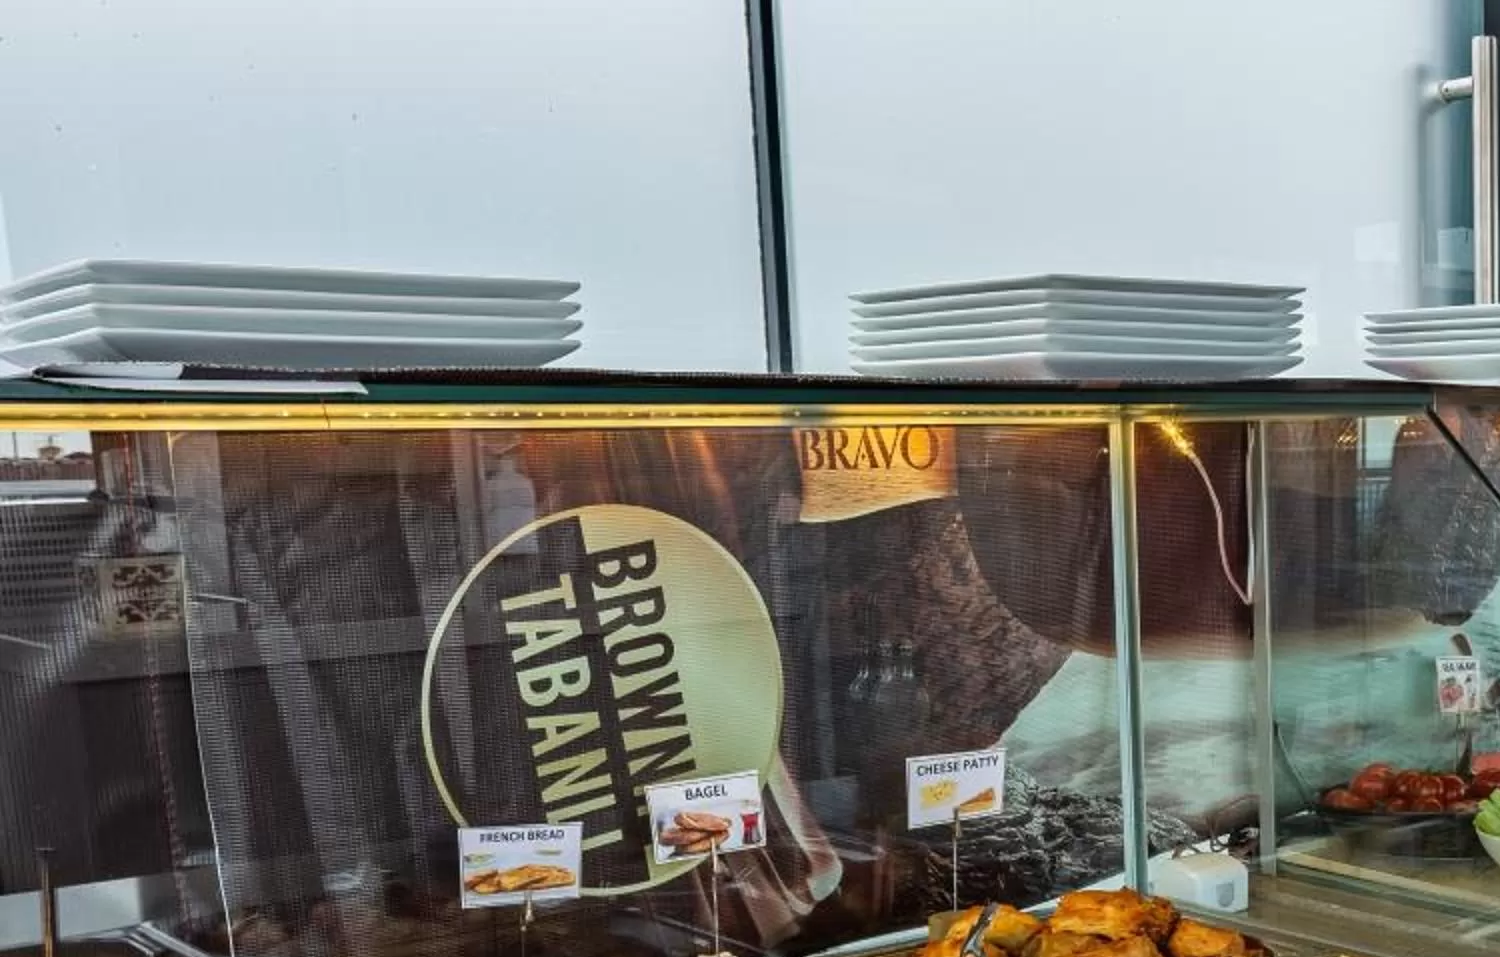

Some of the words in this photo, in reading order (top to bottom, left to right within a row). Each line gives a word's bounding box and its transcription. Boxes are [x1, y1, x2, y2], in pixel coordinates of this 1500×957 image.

[801, 424, 940, 470] BRAVO
[591, 539, 697, 816] BROWN
[917, 762, 960, 777] CHEESE
[963, 755, 999, 770] PATTY
[685, 784, 728, 800] BAGEL
[480, 831, 525, 843] FRENCH
[527, 828, 565, 841] BREAD
